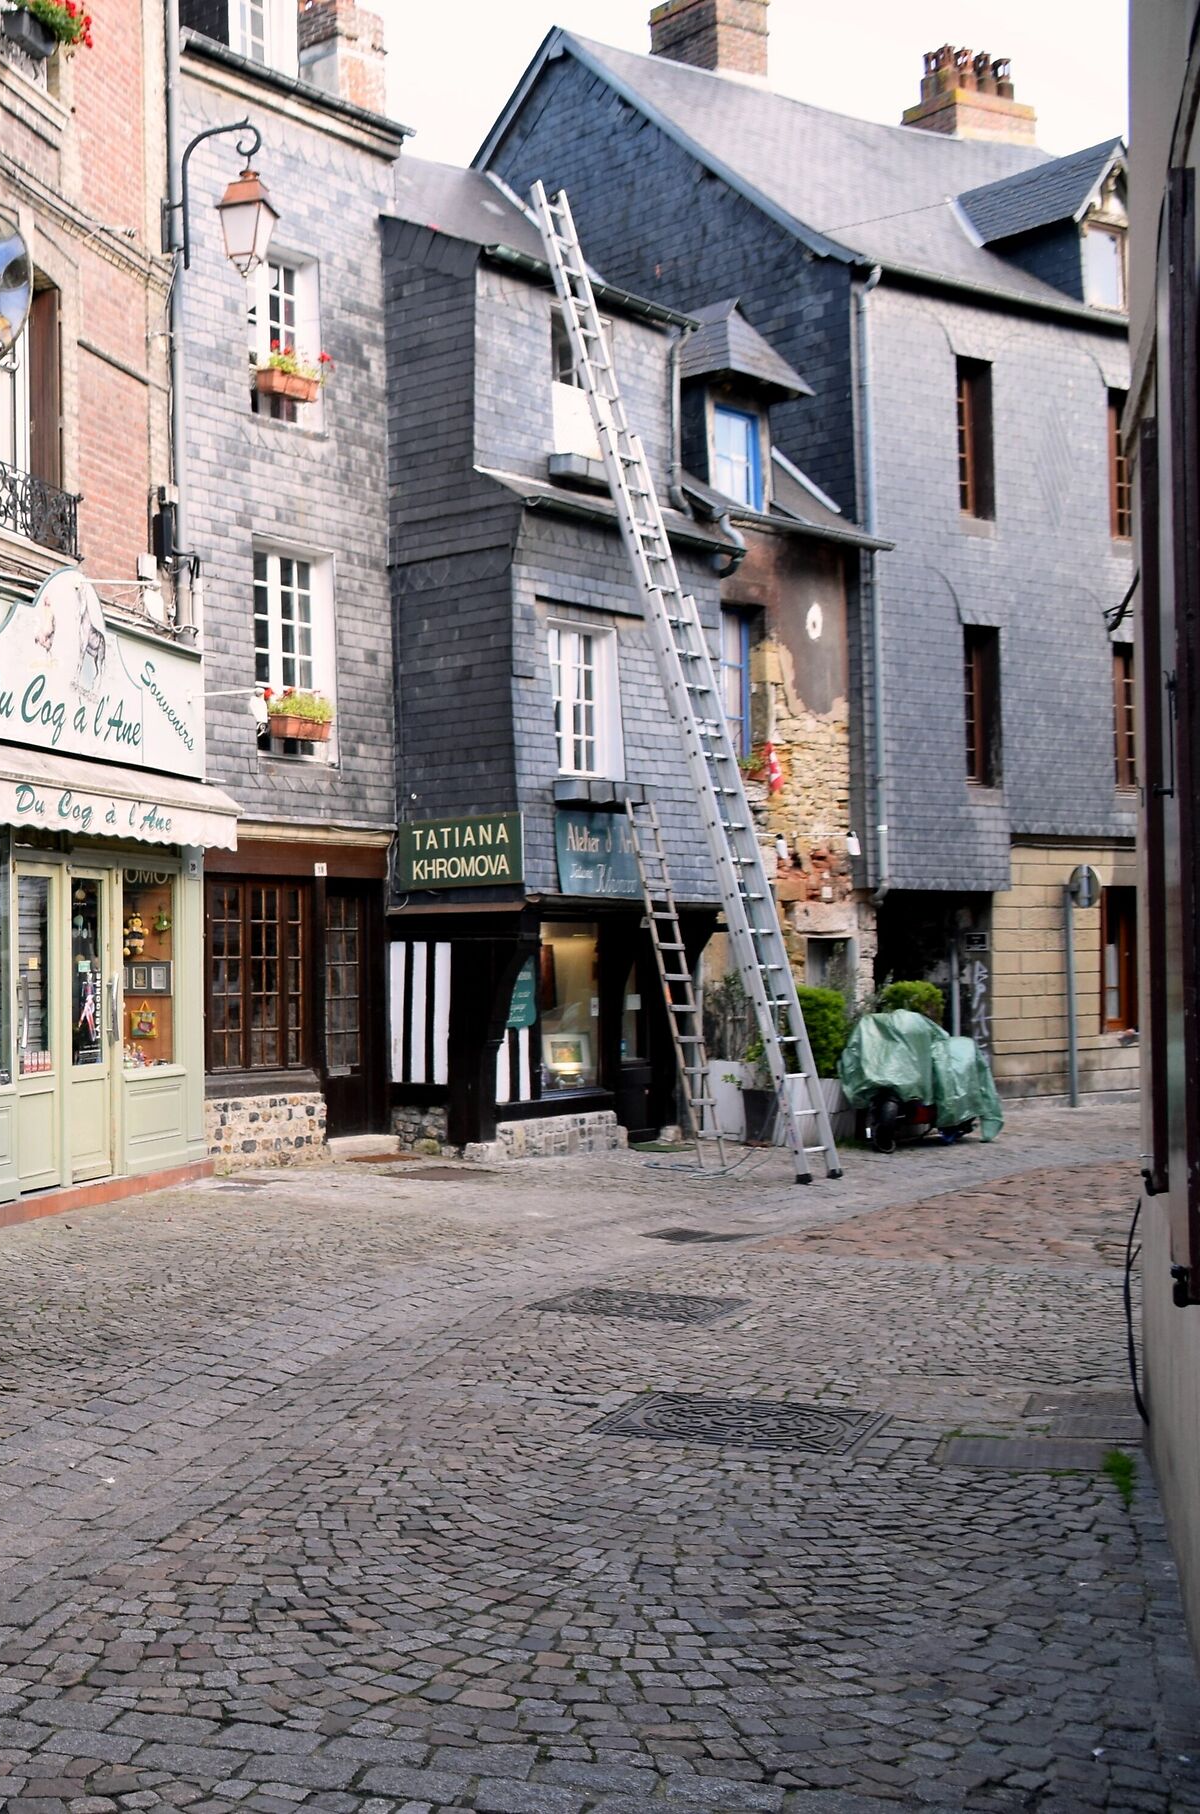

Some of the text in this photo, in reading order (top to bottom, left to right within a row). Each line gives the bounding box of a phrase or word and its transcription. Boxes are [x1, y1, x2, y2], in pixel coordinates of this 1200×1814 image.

[20, 674, 67, 746] Coq
[140, 660, 194, 751] Souvenirs
[15, 784, 45, 814] Du
[57, 790, 93, 829] Coq
[105, 802, 117, 823] à
[412, 823, 509, 851] TATIANA
[412, 853, 510, 880] KHROMOVA
